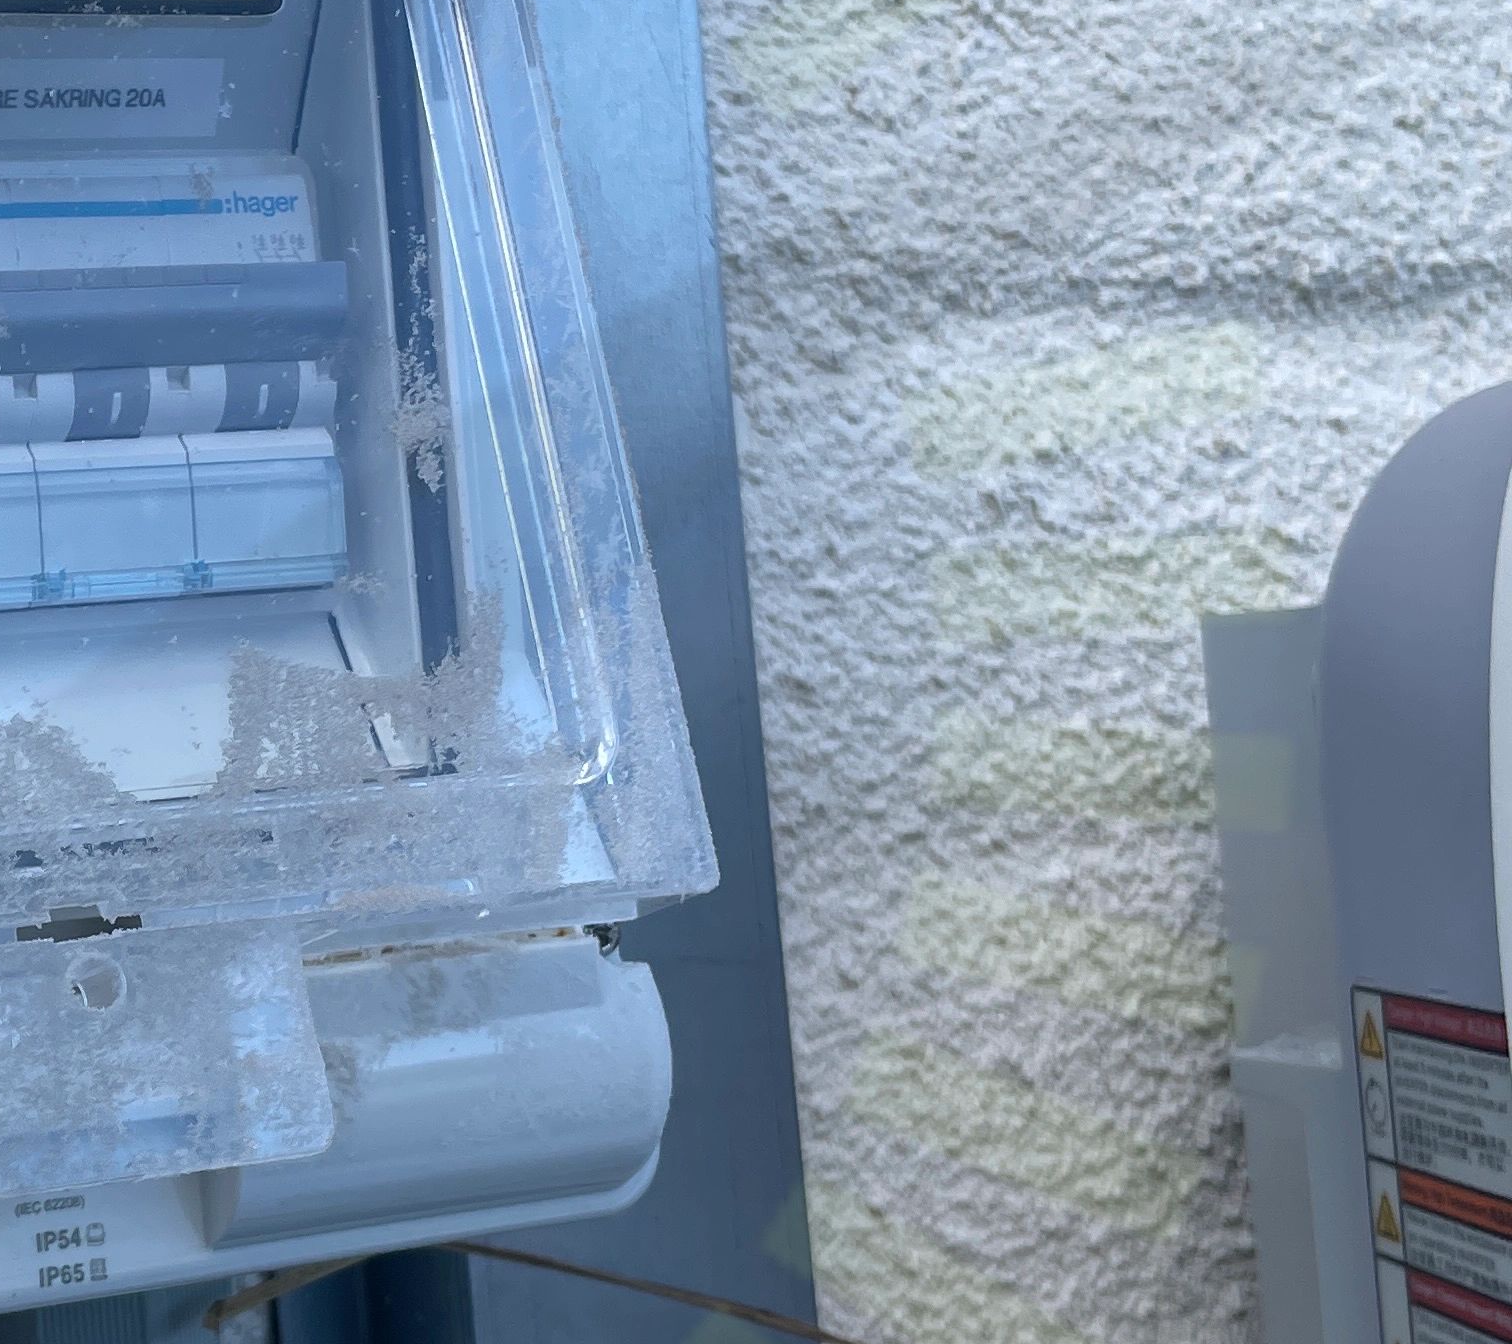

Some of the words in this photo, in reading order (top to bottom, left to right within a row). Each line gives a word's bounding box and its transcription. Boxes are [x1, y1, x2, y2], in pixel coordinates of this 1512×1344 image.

[23, 86, 121, 110] SÄKRING
[125, 86, 167, 109] 20A
[35, 1226, 82, 1254] IP54
[38, 1262, 86, 1289] IP65
